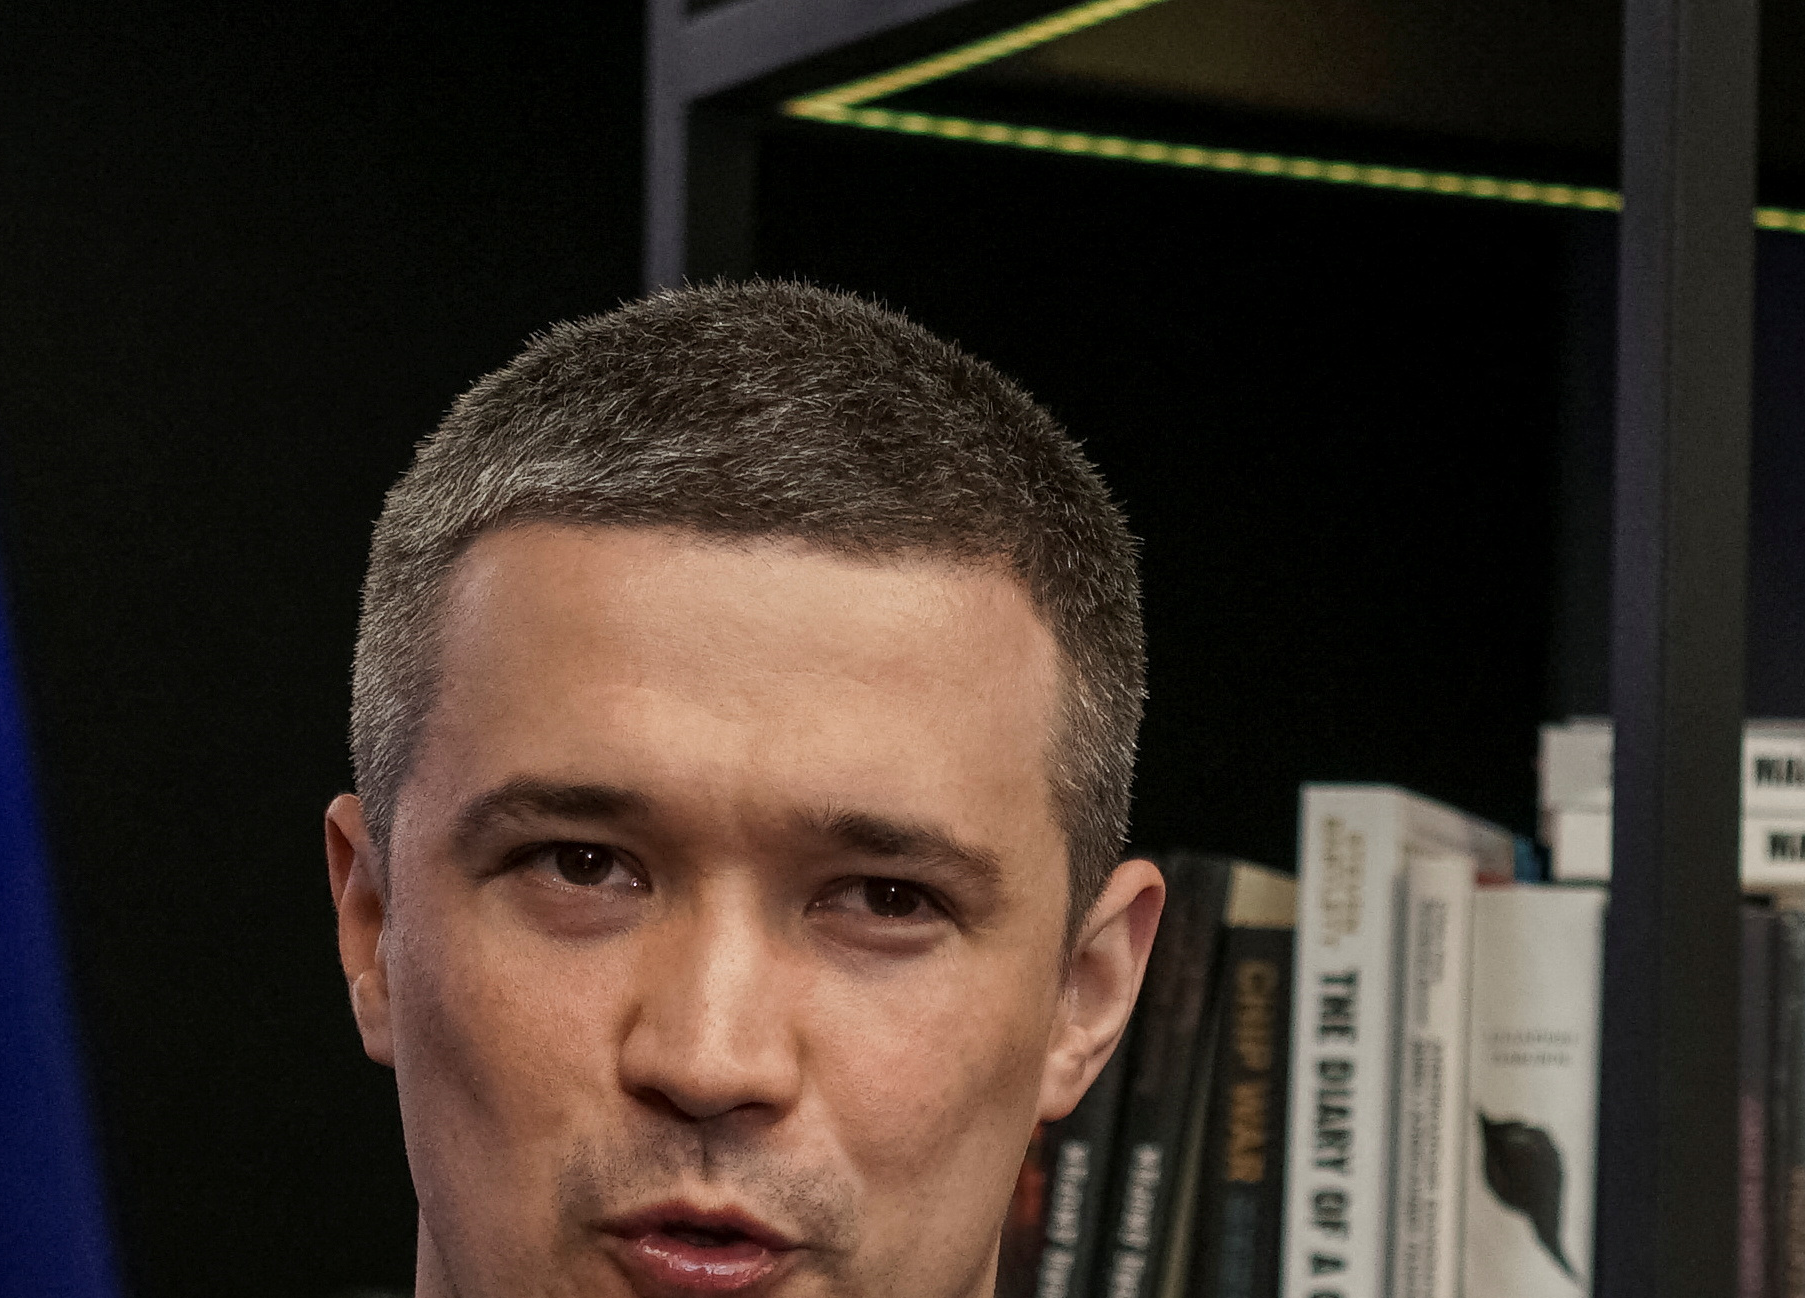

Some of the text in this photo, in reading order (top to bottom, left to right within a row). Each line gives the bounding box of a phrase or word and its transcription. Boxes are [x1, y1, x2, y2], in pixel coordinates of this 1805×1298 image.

[1315, 970, 1359, 1044] THE
[1225, 1080, 1269, 1184] WAR
[1312, 1057, 1357, 1175] DIARY
[1308, 1186, 1351, 1236] OF
[1307, 1250, 1347, 1277] A
